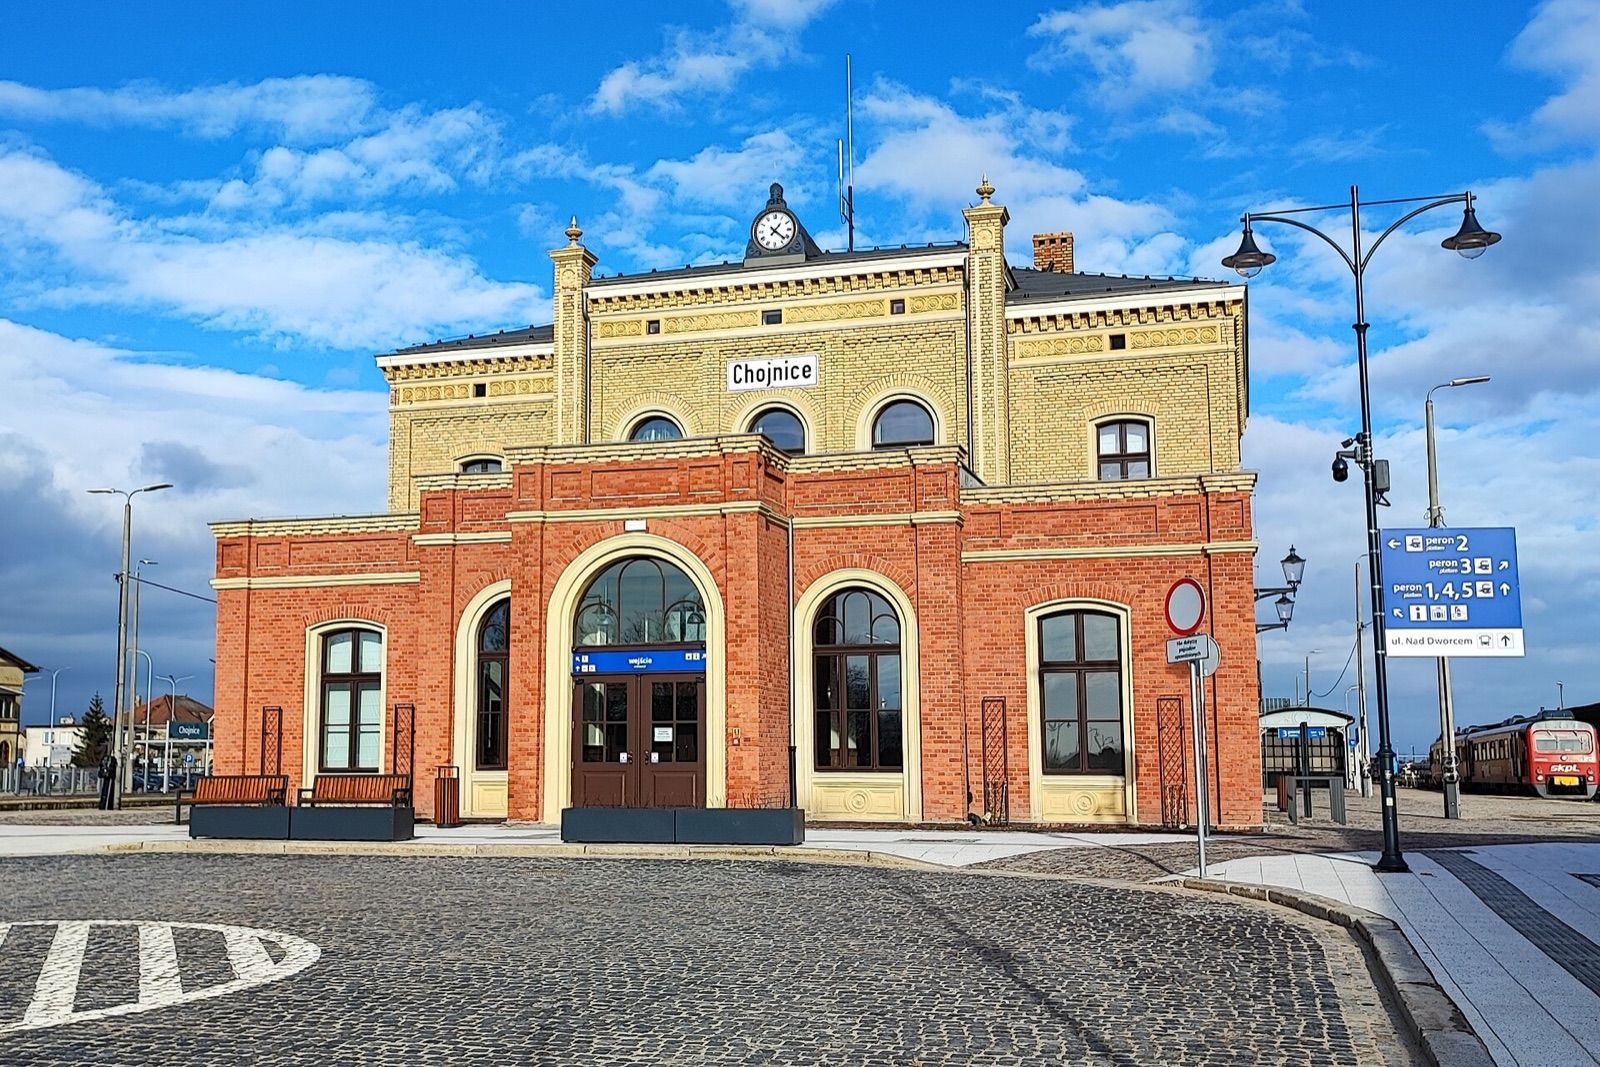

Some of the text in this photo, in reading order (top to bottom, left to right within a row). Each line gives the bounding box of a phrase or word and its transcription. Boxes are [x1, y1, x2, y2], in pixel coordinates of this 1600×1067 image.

[733, 360, 812, 387] Chojnice
[1426, 535, 1469, 551] peron 2
[1429, 558, 1472, 574] peron 3
[1393, 584, 1422, 594] peron
[1406, 637, 1425, 645] Nad
[1427, 637, 1473, 645] Dworcem
